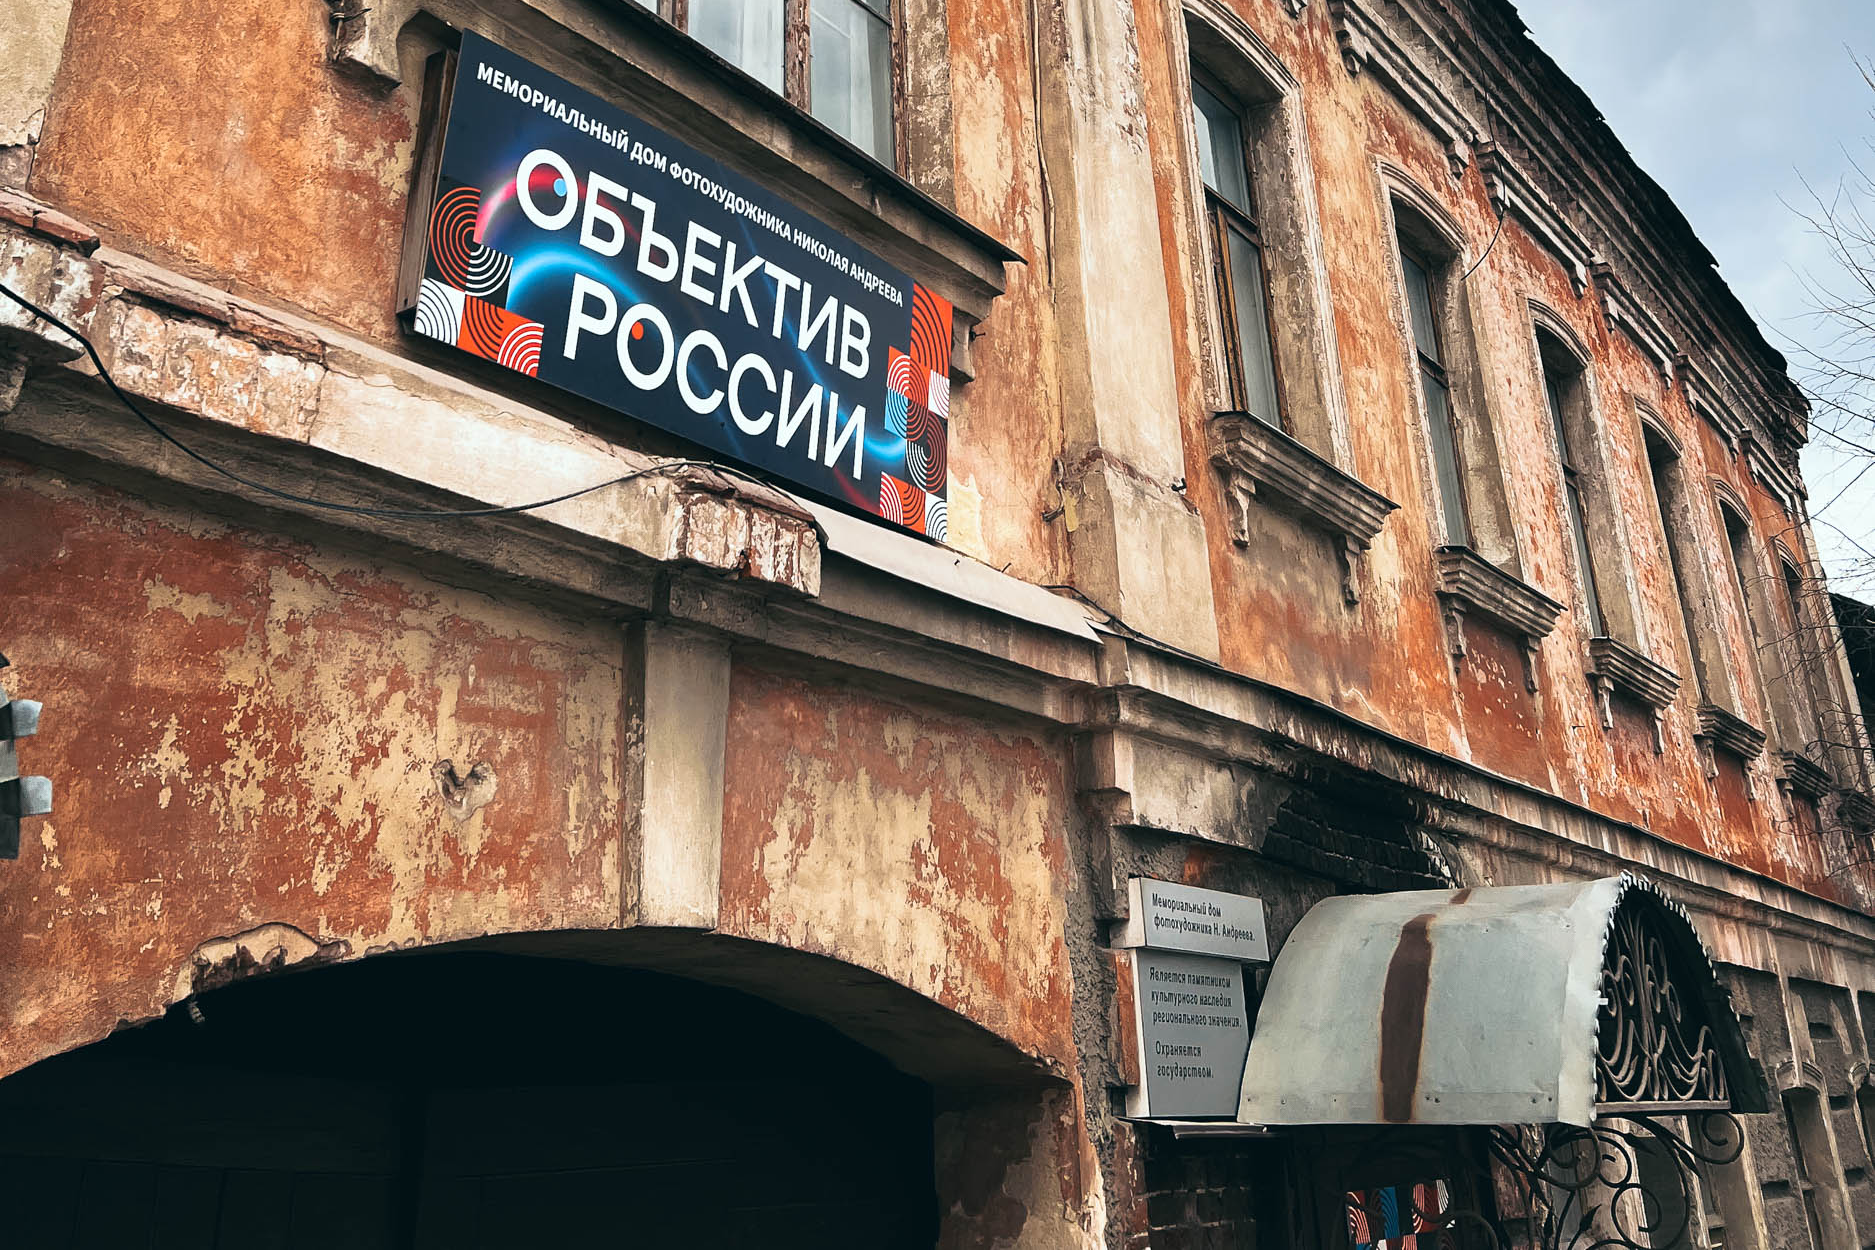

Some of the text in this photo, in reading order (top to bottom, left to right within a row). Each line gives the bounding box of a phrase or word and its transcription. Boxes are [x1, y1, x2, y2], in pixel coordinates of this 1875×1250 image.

[476, 62, 904, 308] МЕМОРИАЛЬНЫЙ ДОМ ФОТОХУДОЖНИКА НИКОЛАЯ АНДРЕЕВА
[516, 148, 872, 380] ОБЪЕКТИВ
[562, 273, 867, 481] РОССИИ
[1152, 892, 1222, 918] Мемориальный дом
[1153, 915, 1256, 942] фотохудожника Н. Андреева.
[1149, 967, 1231, 988] Является памятником
[1151, 990, 1232, 1008] культурного наследия
[1152, 1011, 1242, 1028] регионального значения.
[1155, 1040, 1202, 1057] Охраняется
[1157, 1063, 1214, 1080] государством.
